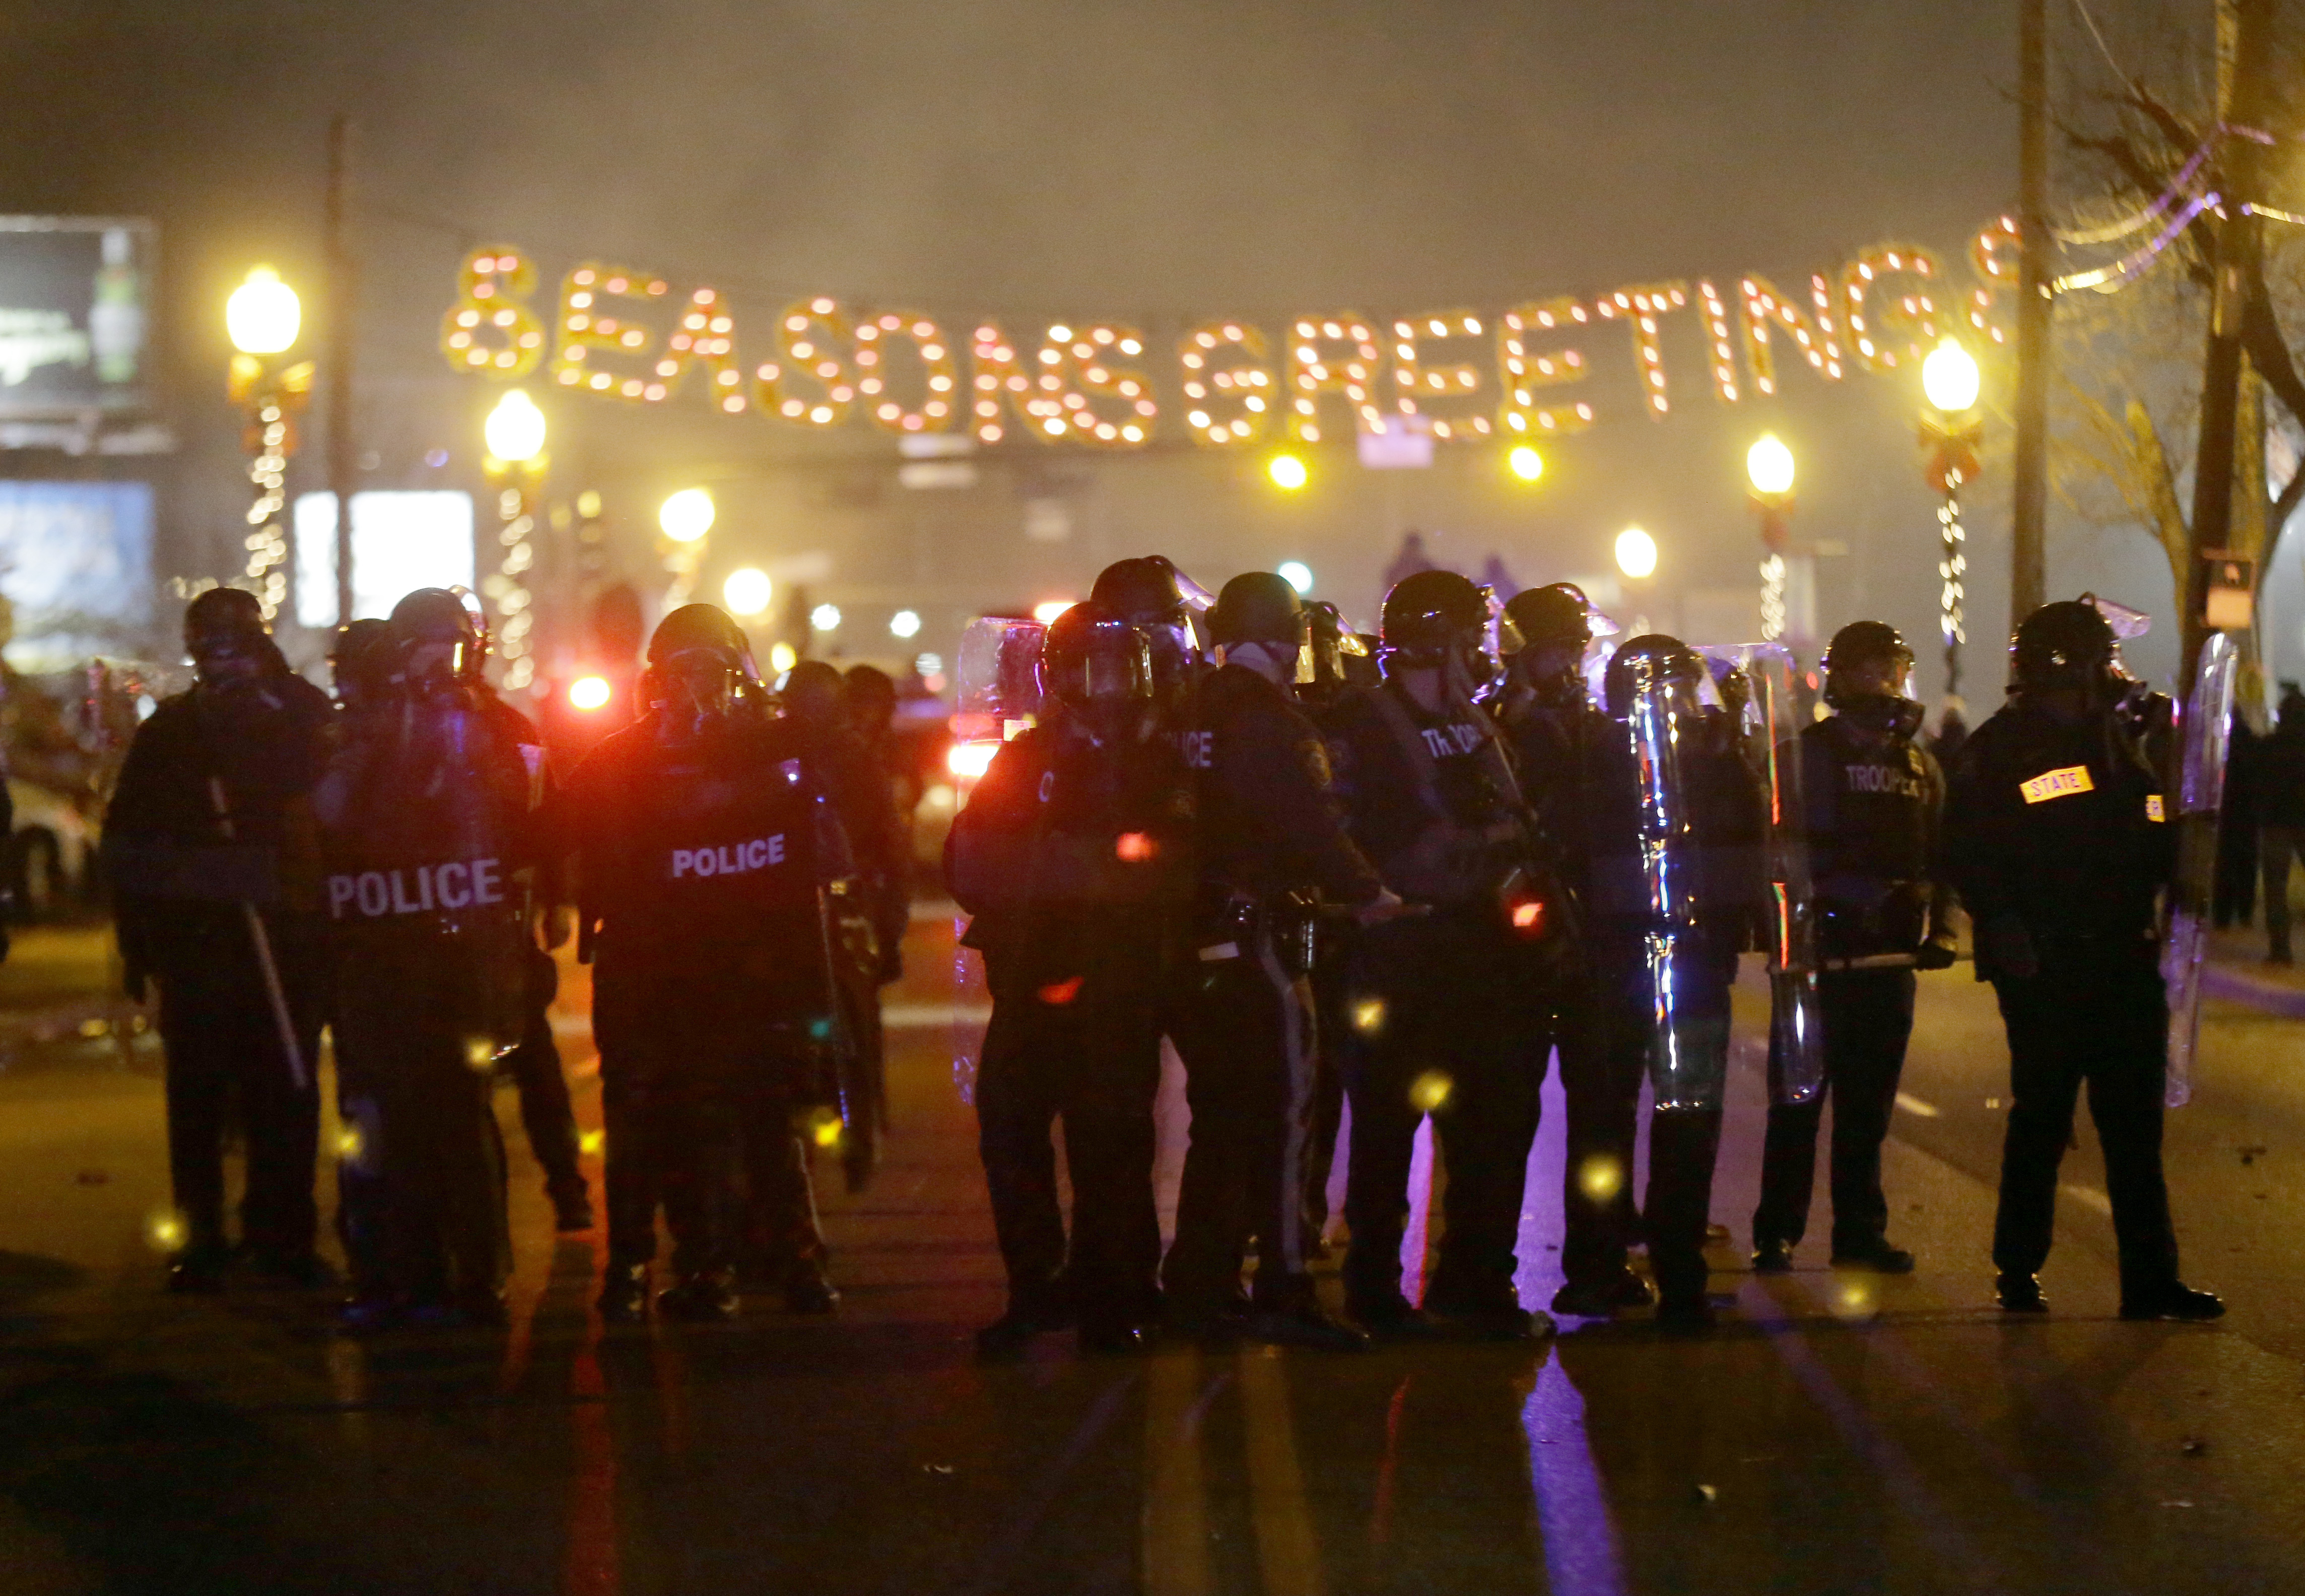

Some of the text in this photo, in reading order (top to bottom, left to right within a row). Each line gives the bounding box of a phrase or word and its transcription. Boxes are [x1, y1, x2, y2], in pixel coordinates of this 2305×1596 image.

[2030, 772, 2080, 797] STATE
[673, 834, 785, 878] POLICE
[329, 858, 503, 919] POLICE
